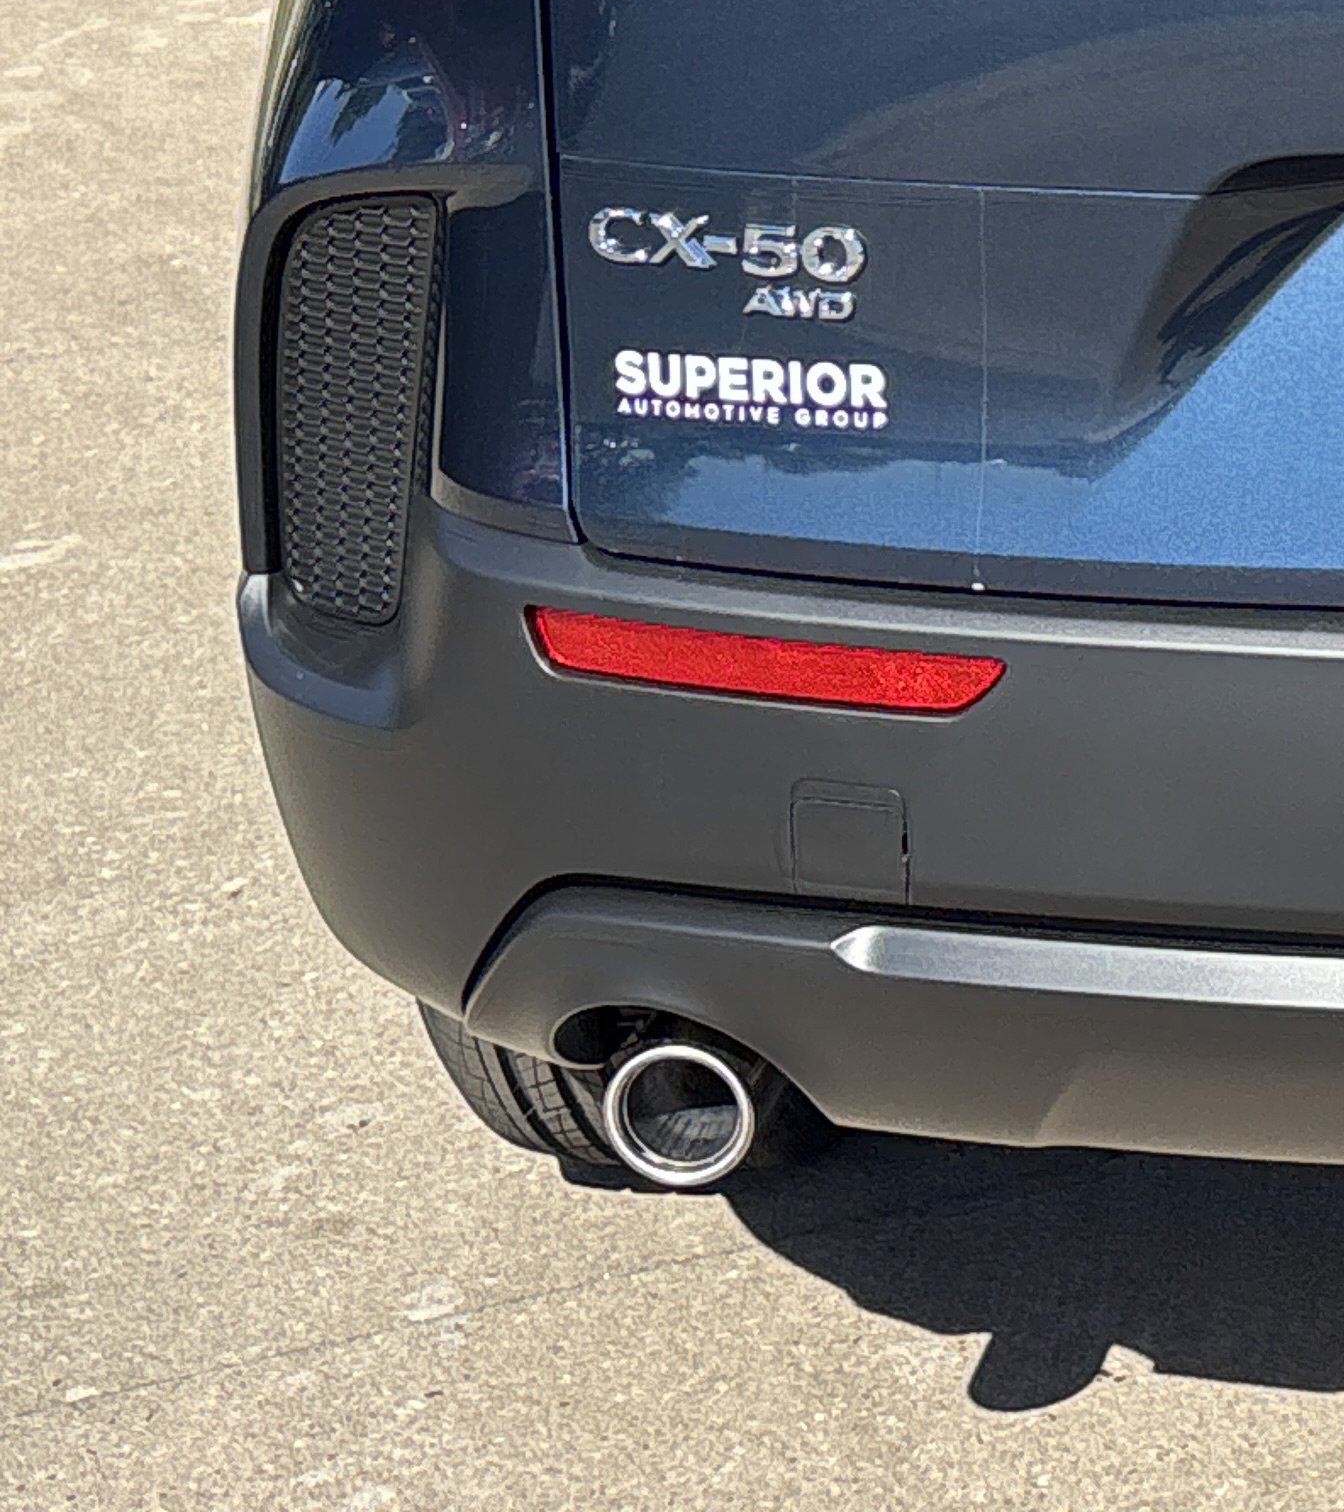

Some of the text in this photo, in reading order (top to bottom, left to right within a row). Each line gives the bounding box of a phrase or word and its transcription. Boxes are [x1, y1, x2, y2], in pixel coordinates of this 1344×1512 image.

[588, 206, 867, 282] CX-50
[742, 285, 855, 320] AWD
[614, 350, 887, 408] SUPERIOR
[616, 397, 888, 429] AUTOMOTIVE GROUP
